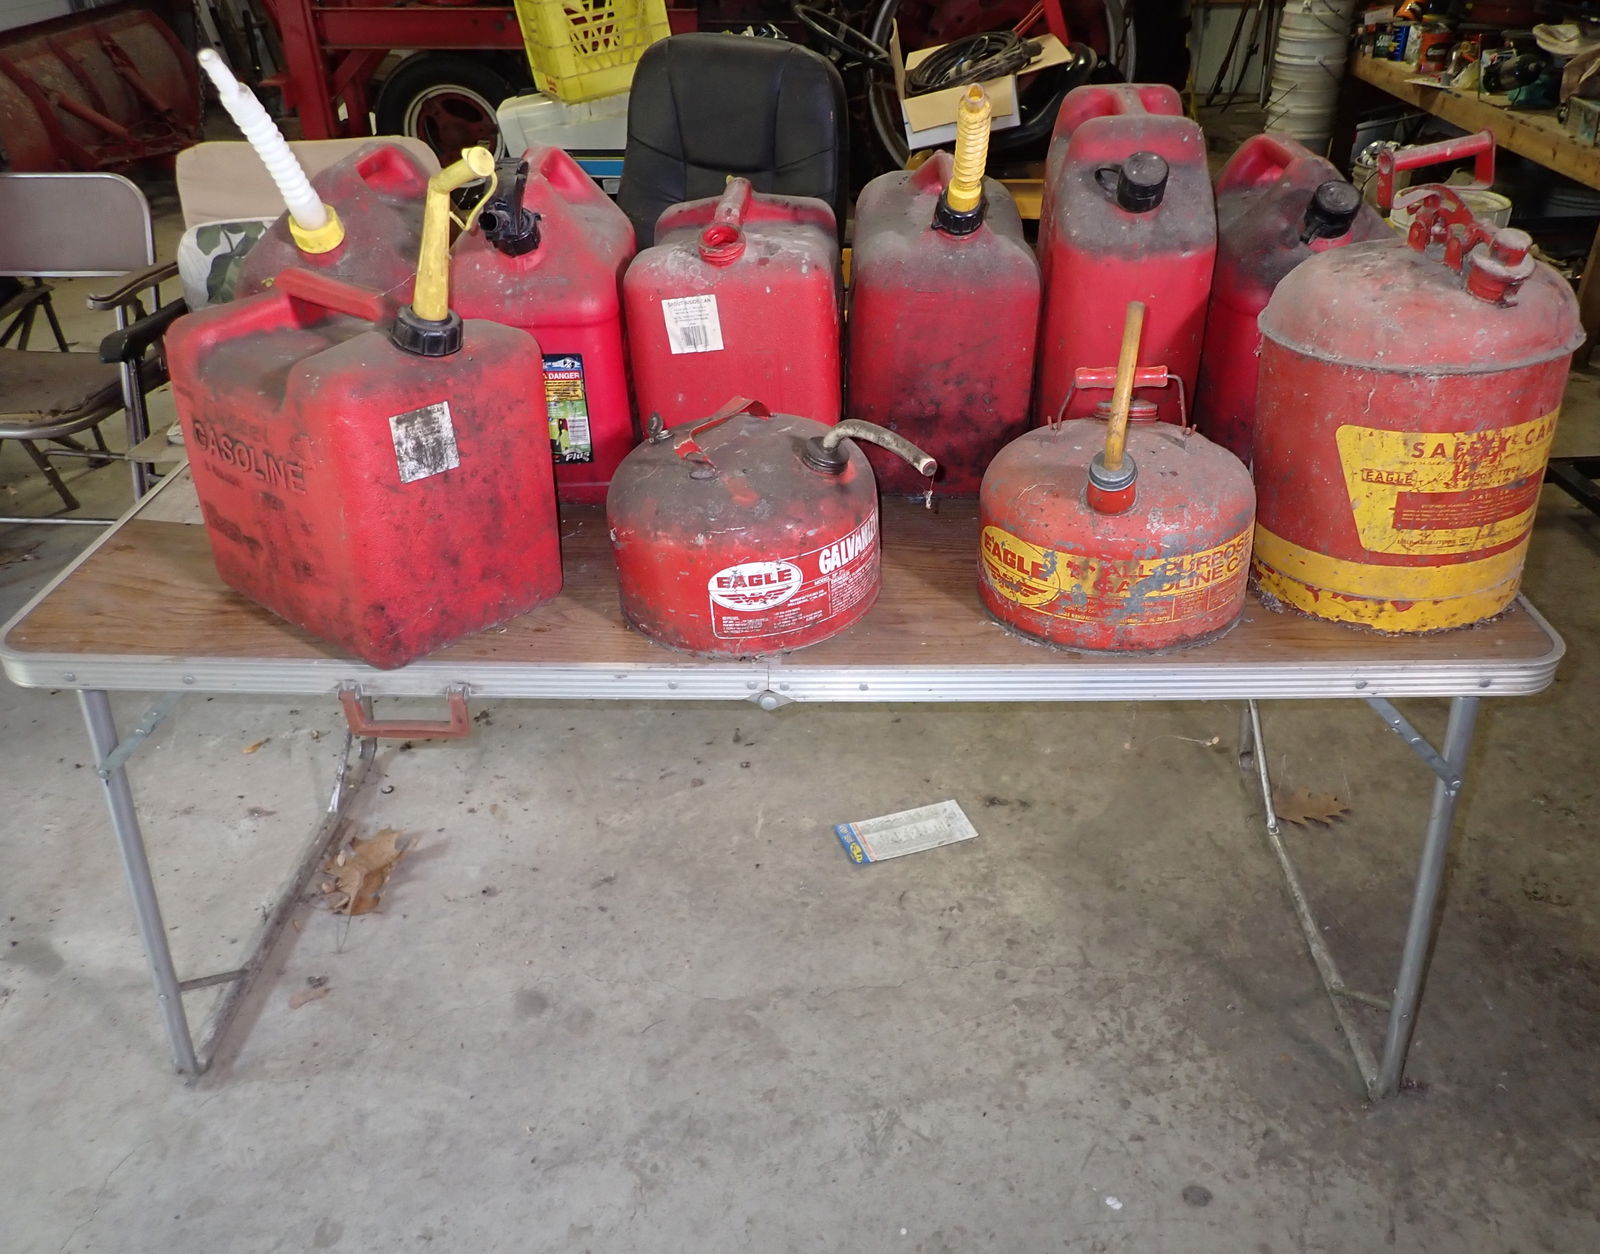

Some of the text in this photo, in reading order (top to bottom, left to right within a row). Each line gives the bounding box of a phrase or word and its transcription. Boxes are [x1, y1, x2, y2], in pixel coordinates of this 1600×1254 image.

[548, 372, 580, 380] DANGER
[193, 420, 307, 495] GASOLINE
[565, 451, 590, 462] Plus
[1366, 470, 1413, 484] EAGLE
[985, 532, 1049, 582] EAGLE
[716, 568, 792, 589] EAGLE
